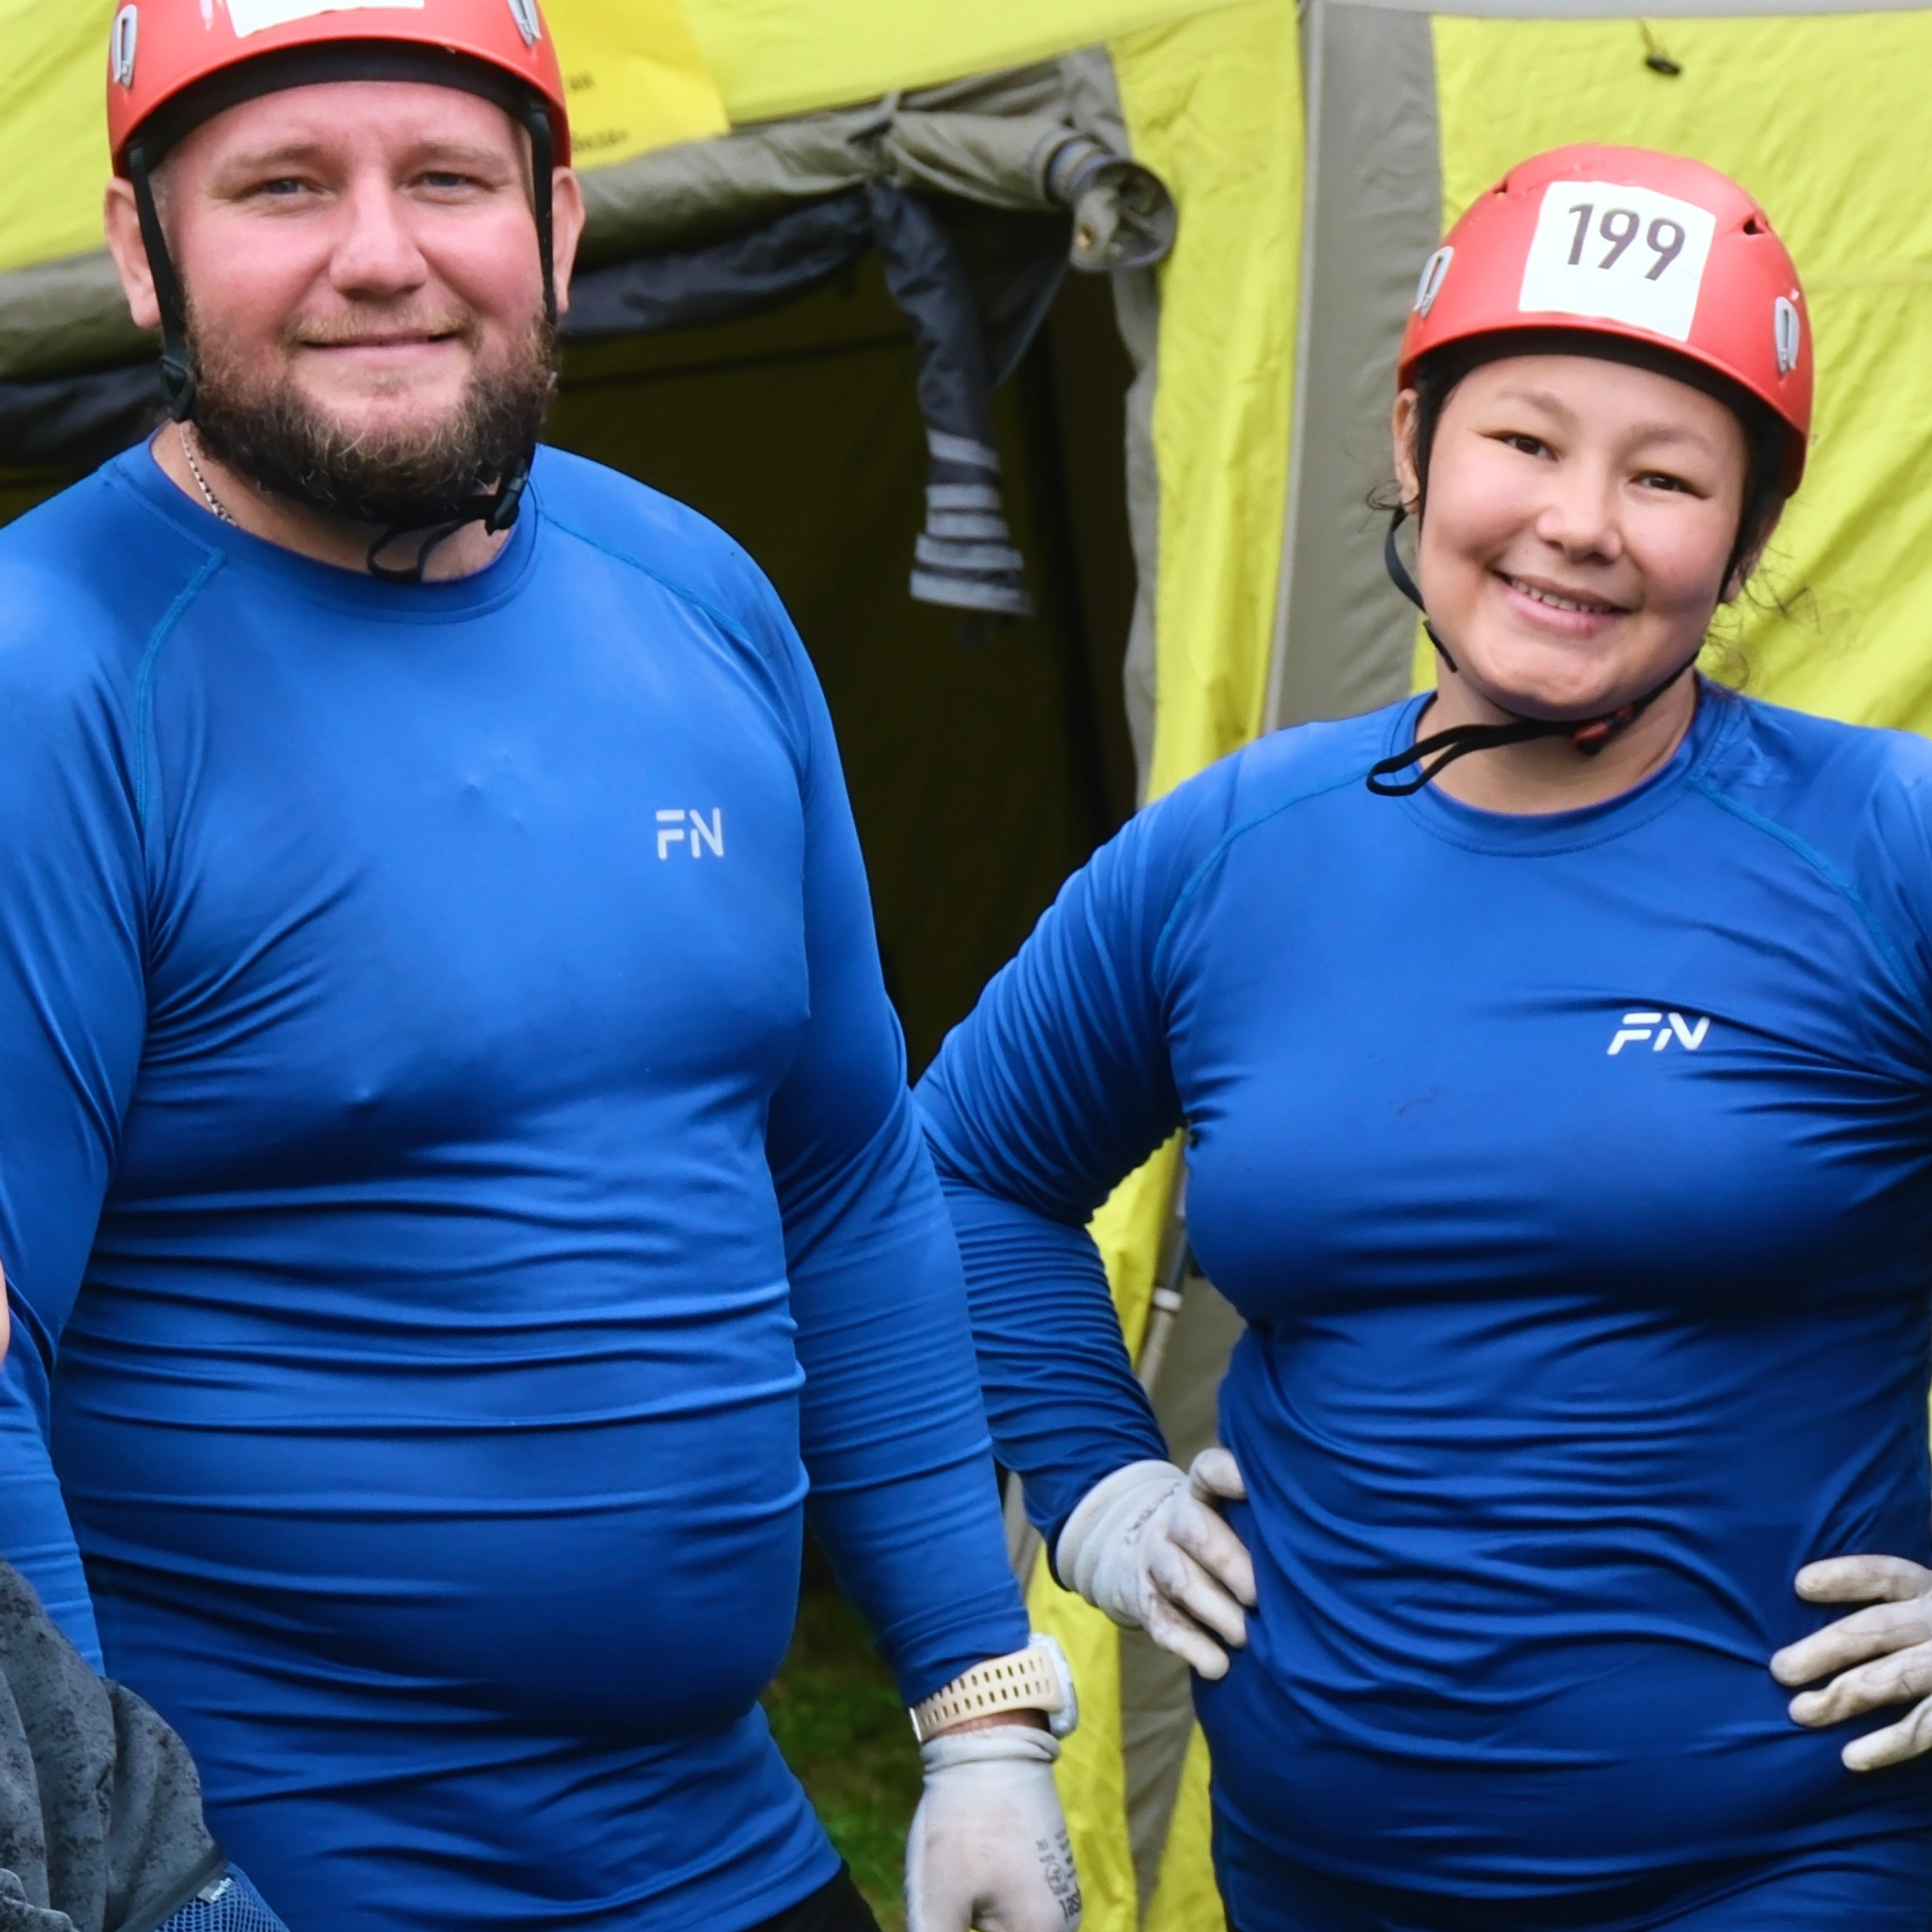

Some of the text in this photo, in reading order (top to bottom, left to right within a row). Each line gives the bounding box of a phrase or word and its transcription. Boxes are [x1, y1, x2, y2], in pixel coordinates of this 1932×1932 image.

[1567, 202, 1685, 281] 199
[656, 808, 724, 860] FN
[1607, 1012, 1710, 1055] FN
